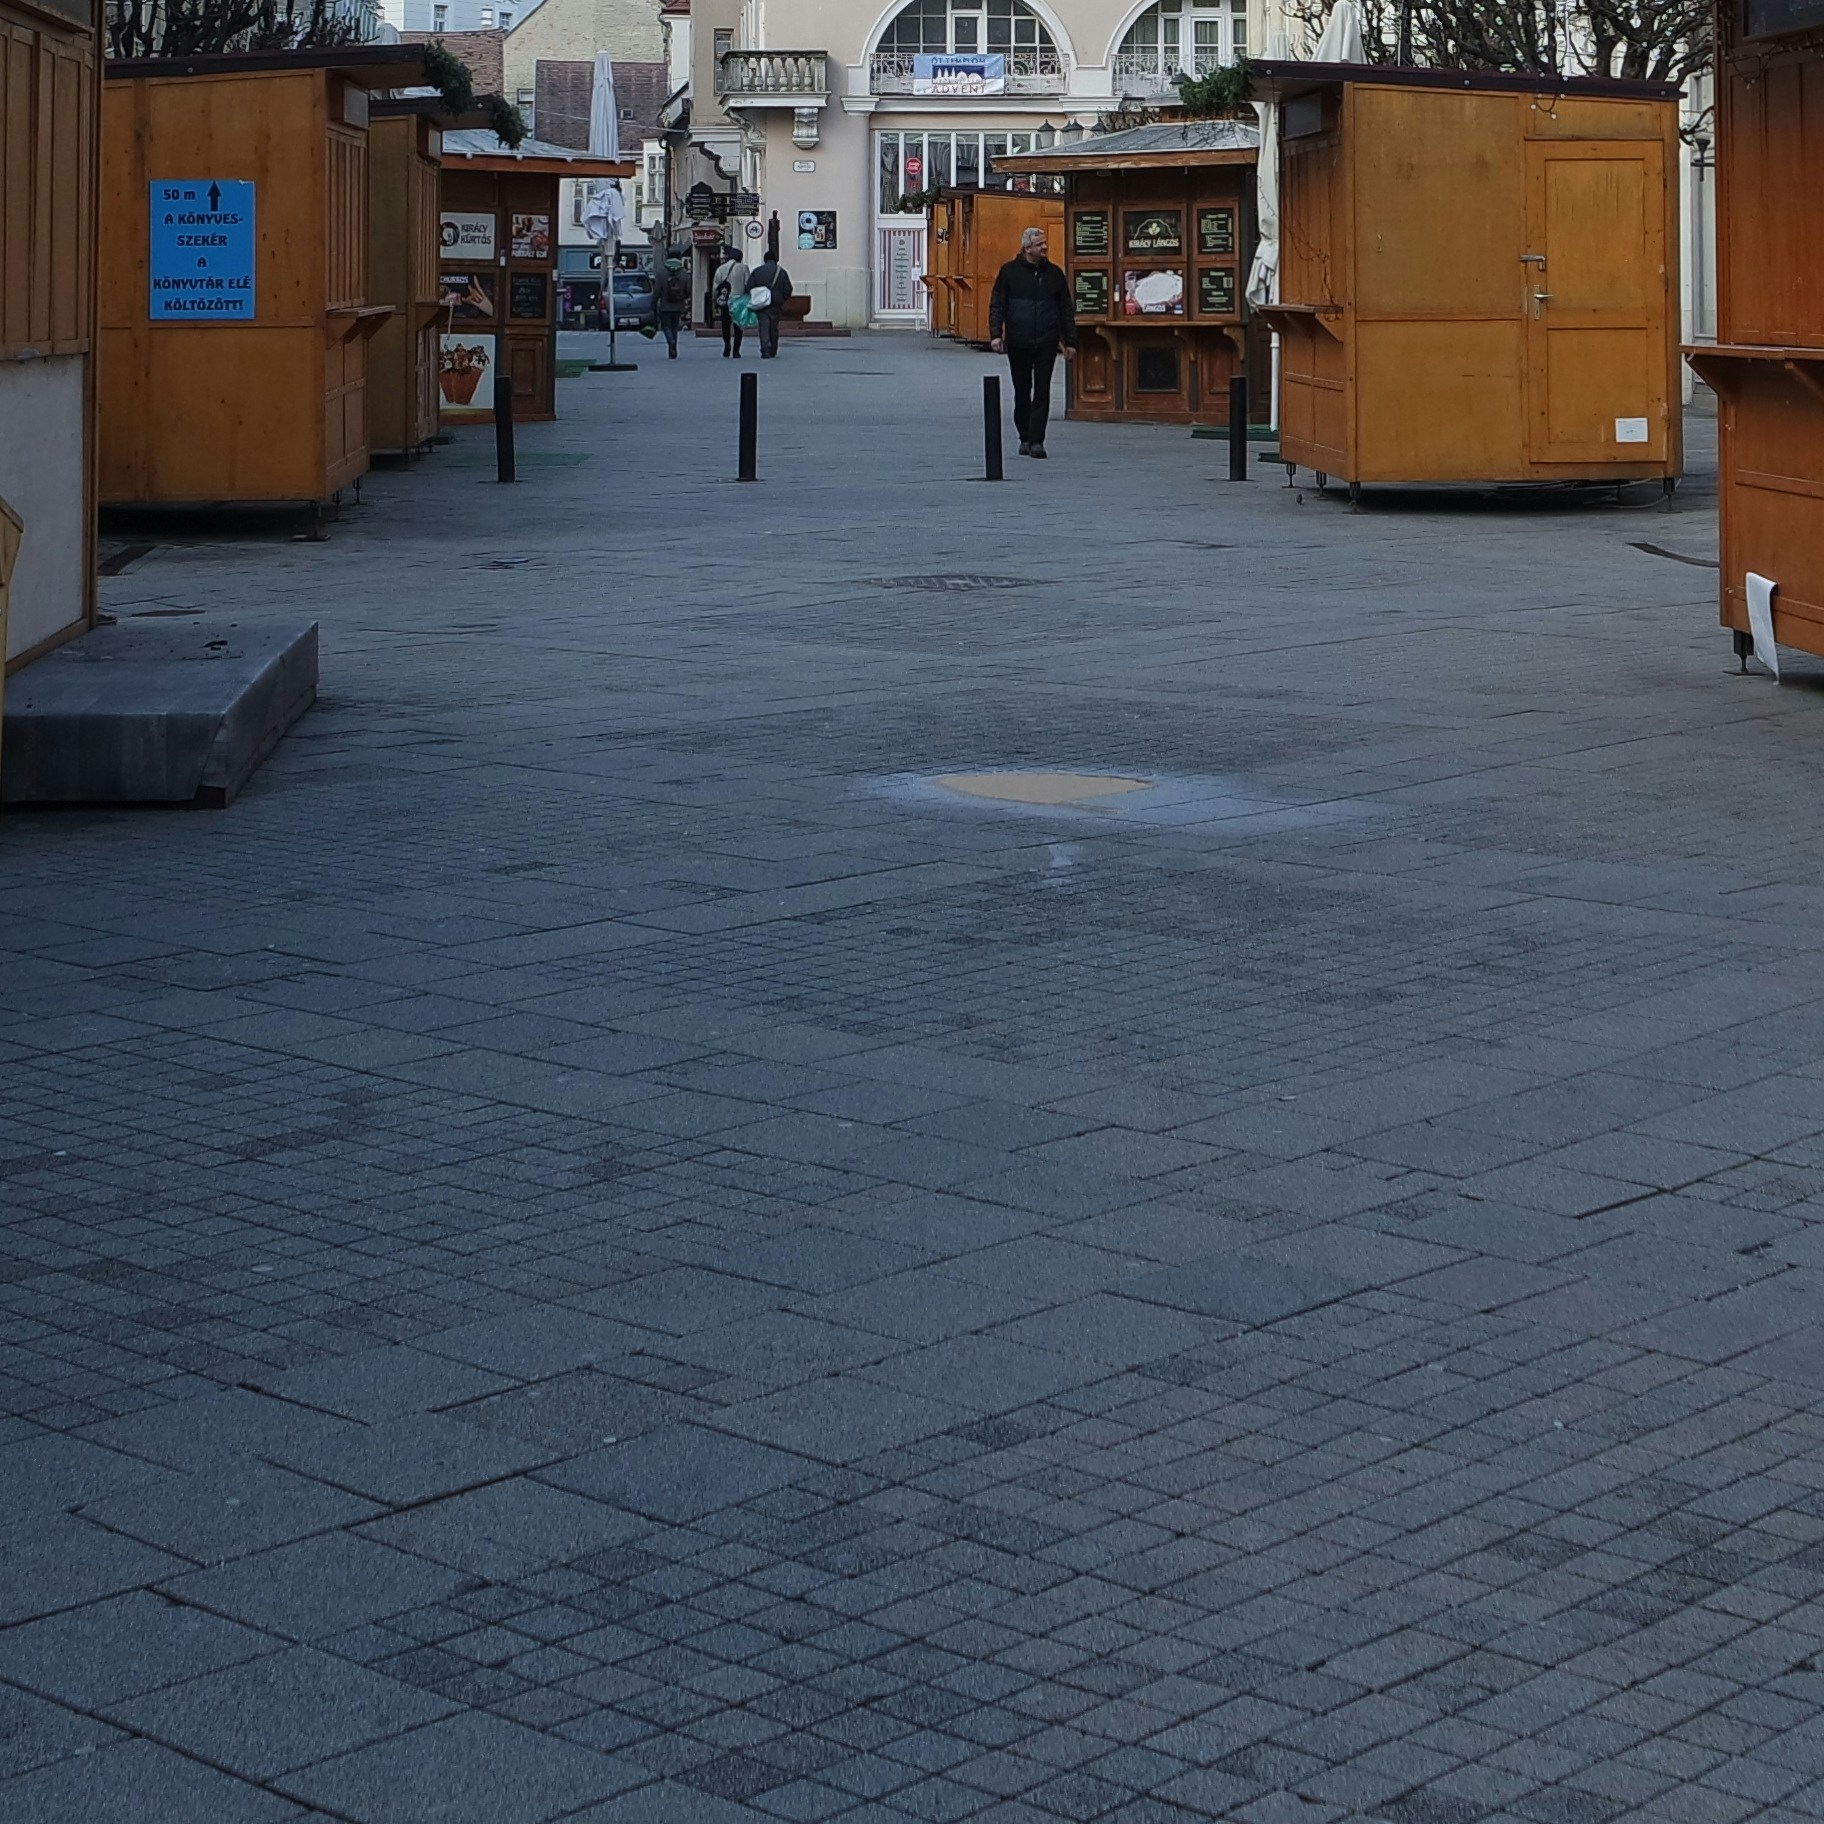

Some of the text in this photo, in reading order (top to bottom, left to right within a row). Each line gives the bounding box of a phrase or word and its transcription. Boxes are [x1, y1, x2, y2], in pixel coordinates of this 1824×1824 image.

[932, 85, 986, 94] ADVENT
[163, 189, 195, 200] 50 m
[164, 211, 244, 224] A KÖNYVES-
[177, 233, 228, 246] SZEKÉR
[197, 257, 207, 267] A
[153, 276, 252, 289] KÖNYVTÁR ELÉ
[163, 297, 244, 311] KÖLTÖZÖTT!
